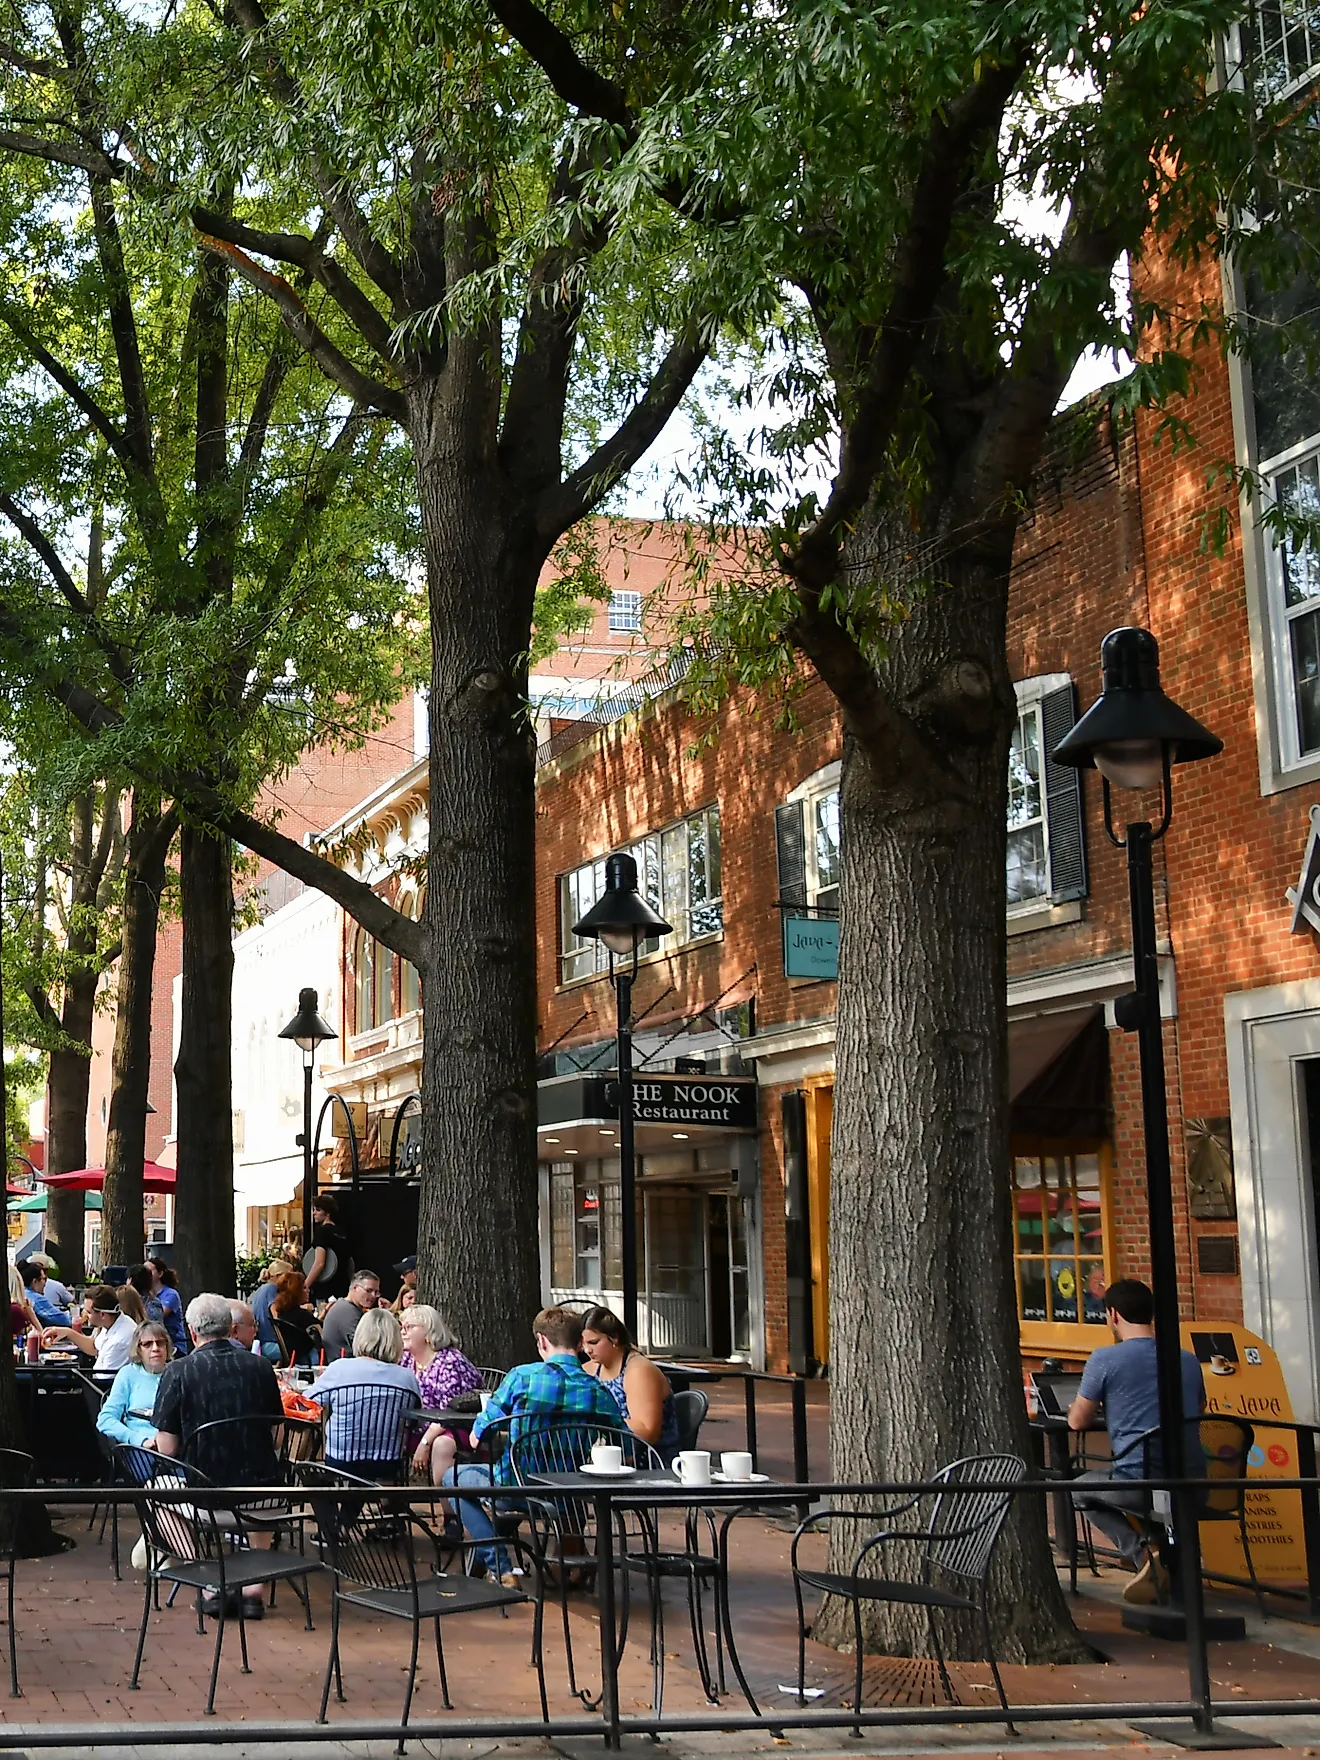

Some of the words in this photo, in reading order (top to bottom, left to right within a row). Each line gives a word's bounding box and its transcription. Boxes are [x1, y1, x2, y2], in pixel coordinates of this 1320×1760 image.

[632, 1084, 662, 1101] HE
[673, 1085, 741, 1104] NOOK
[632, 1102, 729, 1120] Restaurant
[1245, 1492, 1271, 1503] RAPS
[1245, 1507, 1277, 1517] ANINIS
